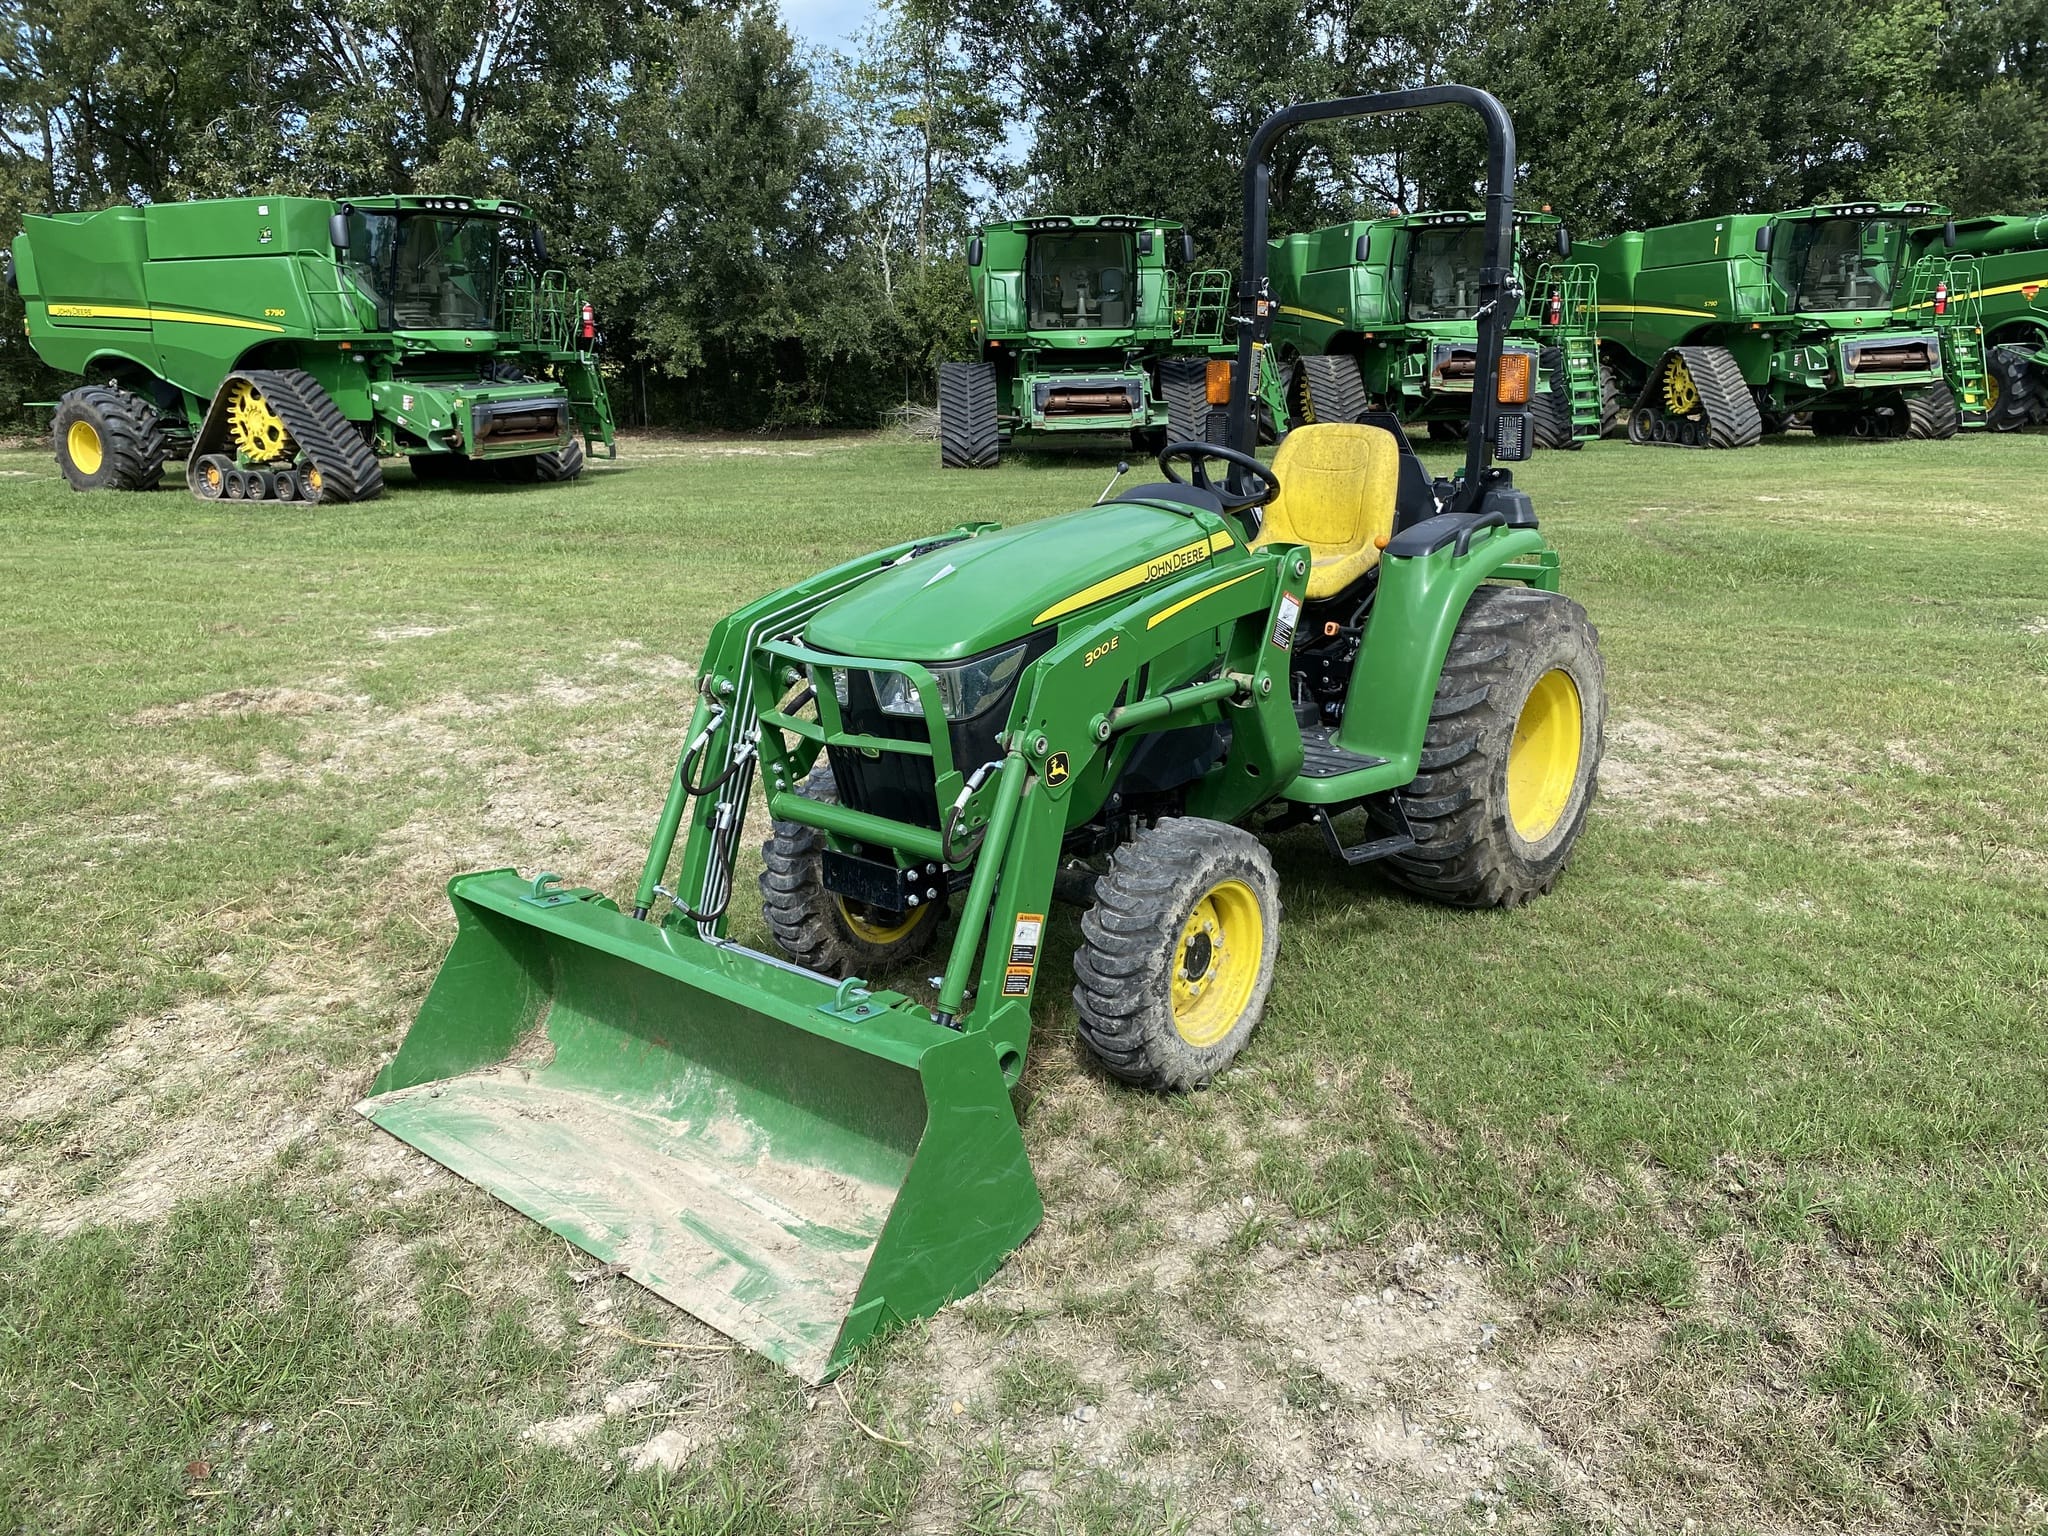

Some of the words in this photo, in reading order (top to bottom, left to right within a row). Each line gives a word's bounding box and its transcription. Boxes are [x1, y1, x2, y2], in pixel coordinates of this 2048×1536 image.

[1714, 236, 1719, 255] 1
[1144, 561, 1173, 582] JOHN
[1173, 546, 1206, 570] DEERE
[1084, 642, 1110, 667] 300
[1111, 635, 1119, 650] E
